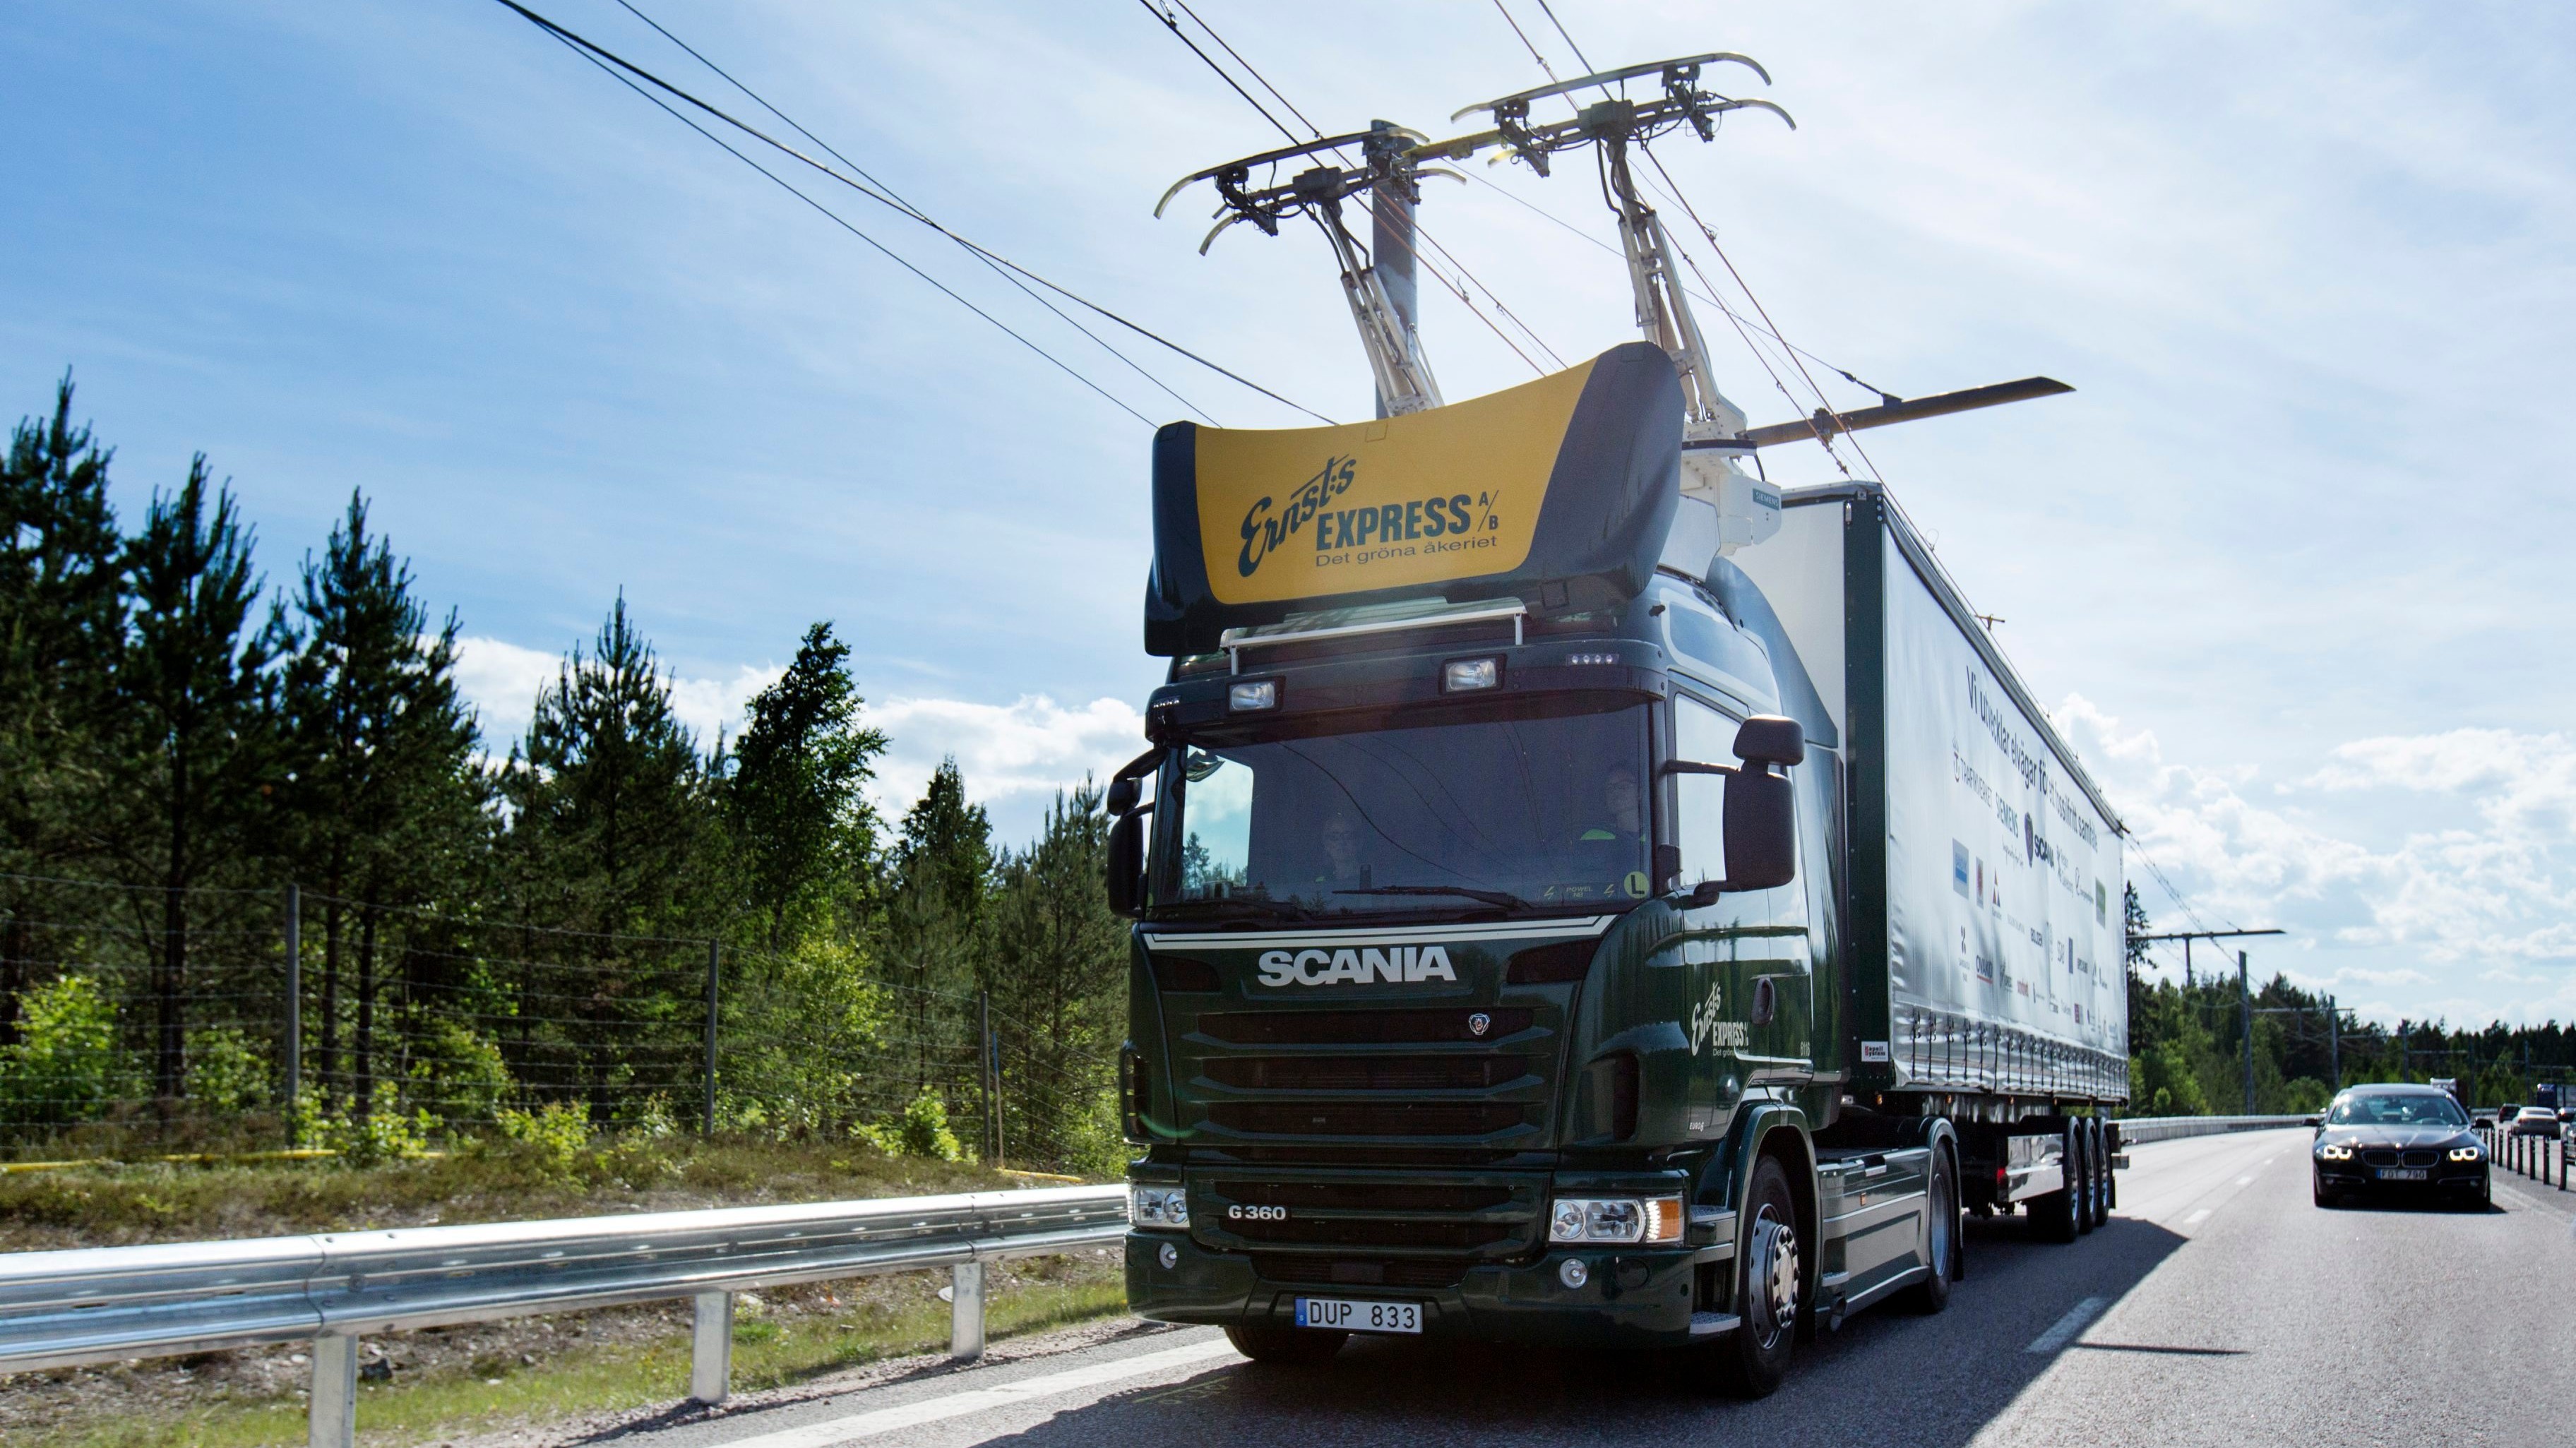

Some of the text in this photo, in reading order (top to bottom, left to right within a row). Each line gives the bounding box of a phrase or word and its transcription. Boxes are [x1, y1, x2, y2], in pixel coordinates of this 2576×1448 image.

[1755, 491, 1779, 506] SIEMENS
[1316, 494, 1472, 551] EXPRESS
[1316, 536, 1498, 567] Det gröna åkeriet
[1966, 665, 1977, 714] Vi
[1980, 690, 2010, 758] utvecklar
[2011, 732, 2037, 790] elvägar
[1996, 792, 2019, 839] SIEMENS
[1630, 874, 1645, 894] L
[1258, 946, 1457, 987] SCANIA
[1228, 1205, 1286, 1220] G 360
[1310, 1302, 1415, 1329] DUP 833
